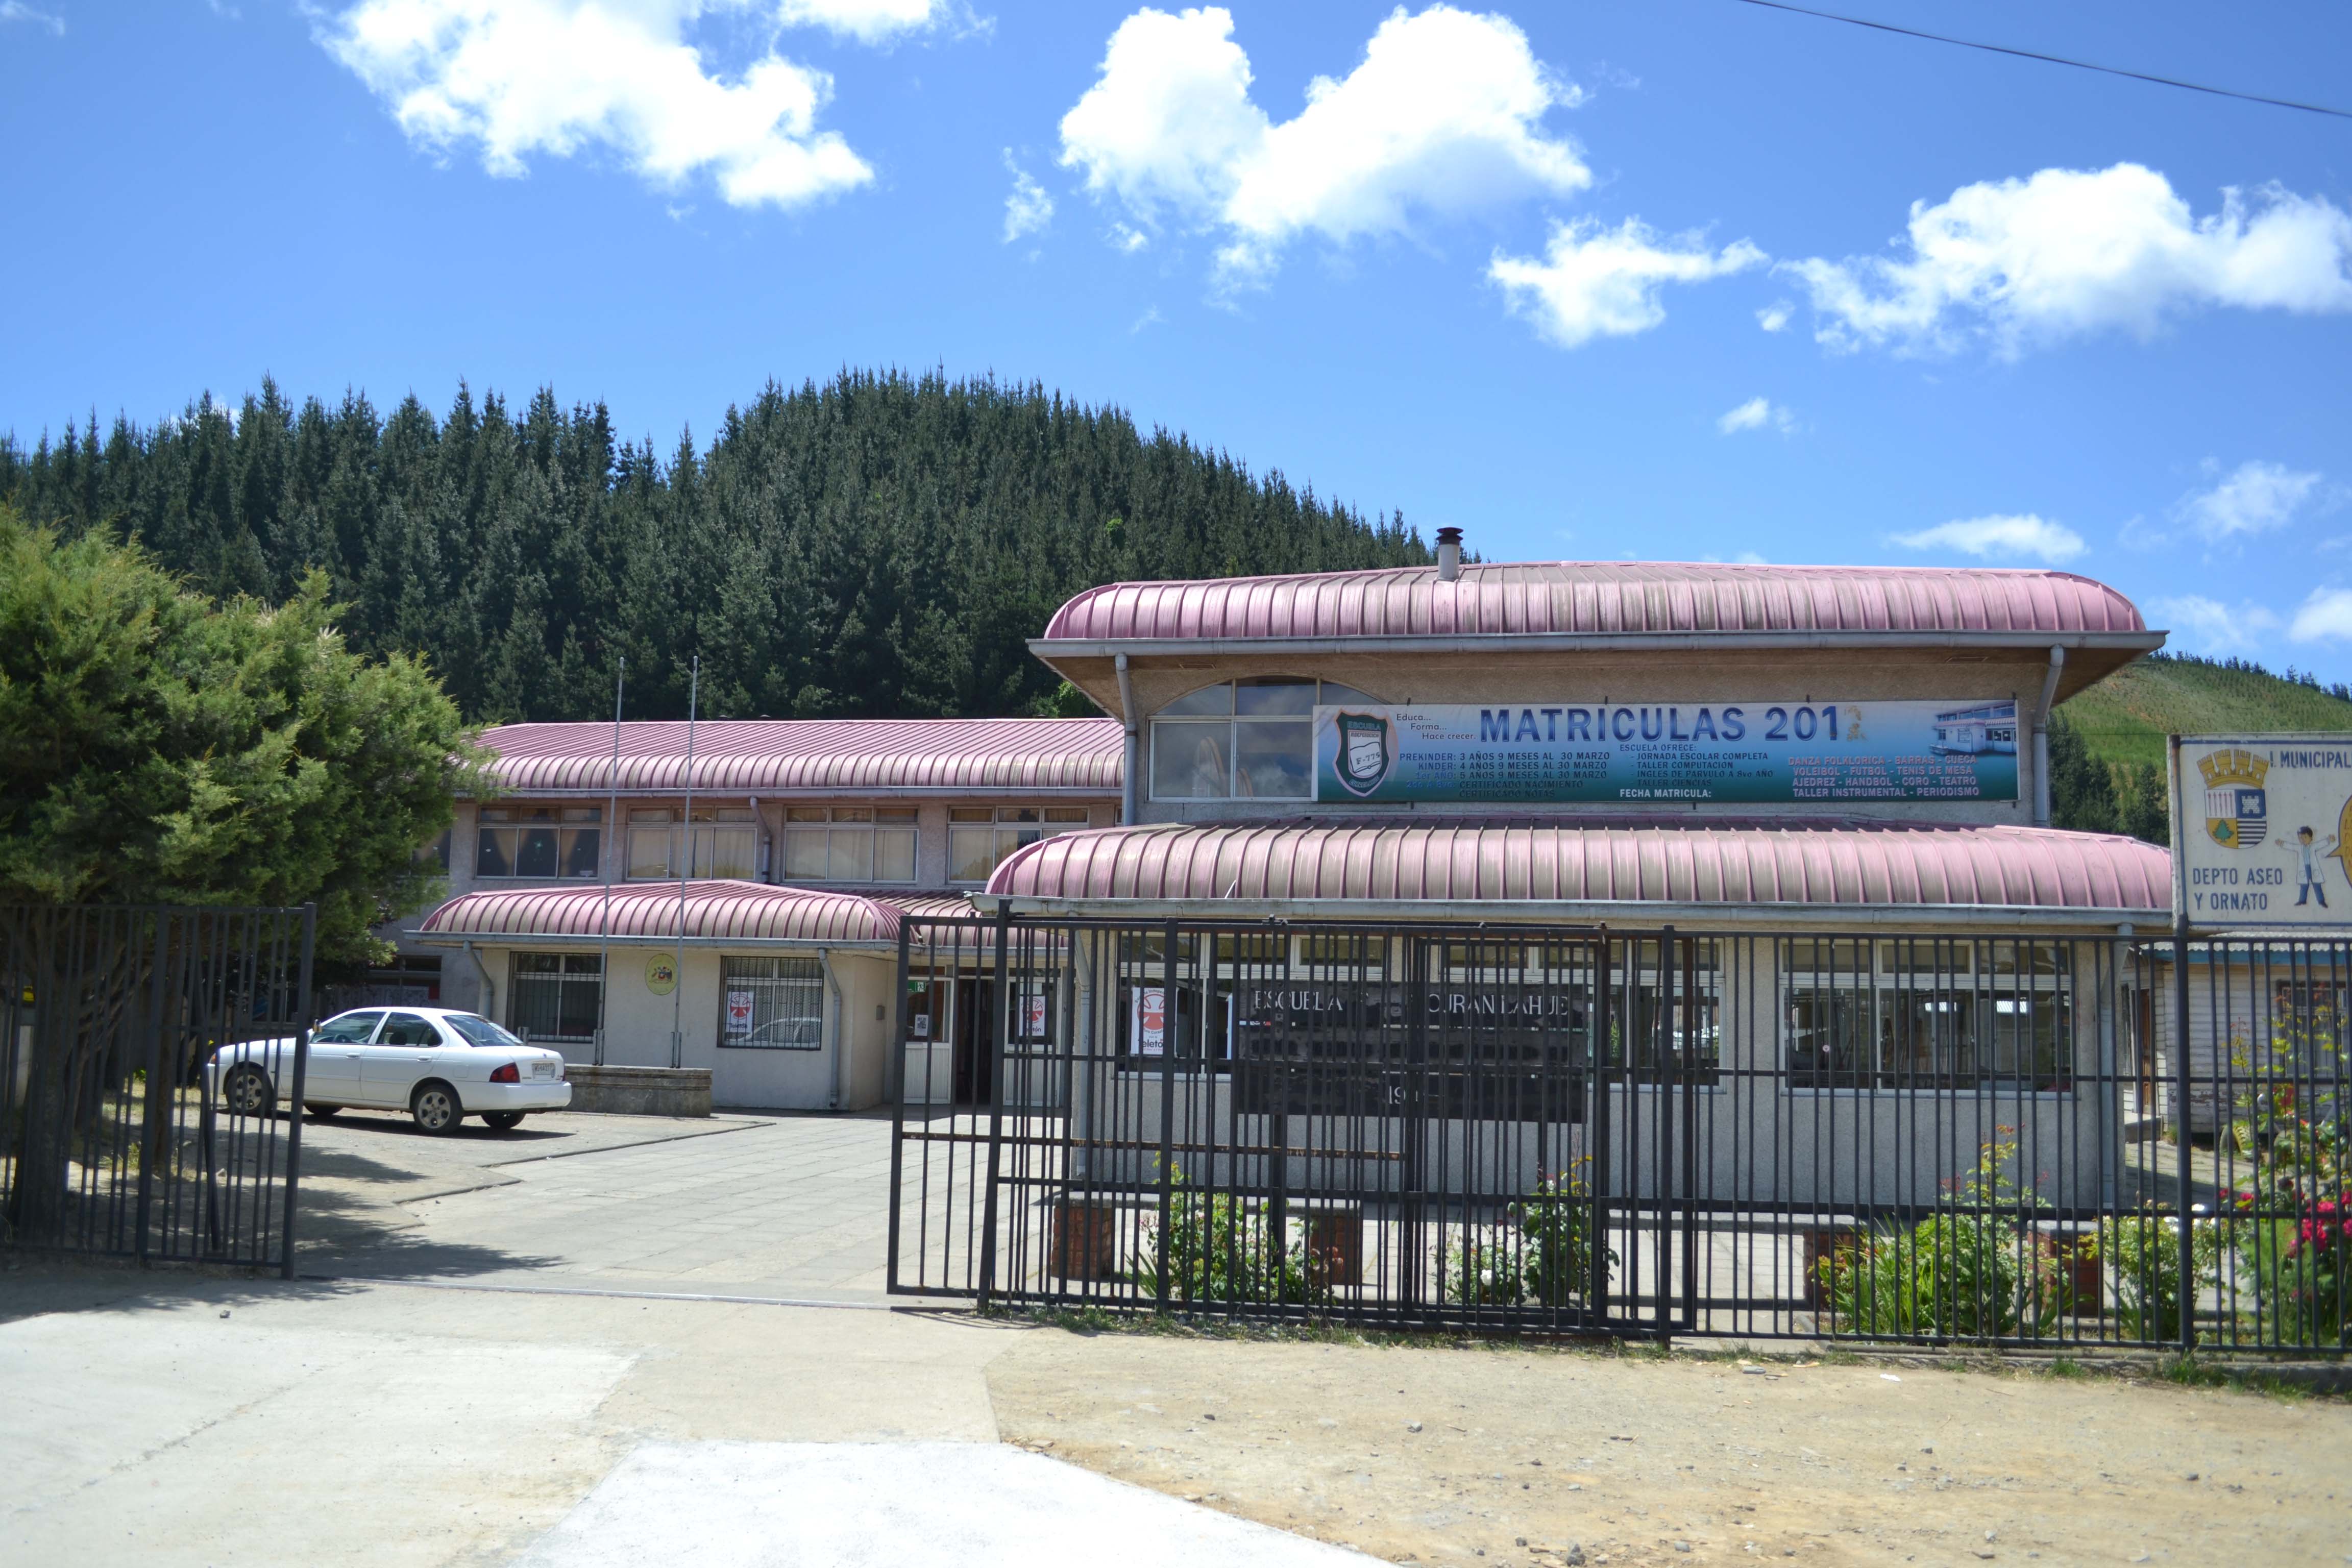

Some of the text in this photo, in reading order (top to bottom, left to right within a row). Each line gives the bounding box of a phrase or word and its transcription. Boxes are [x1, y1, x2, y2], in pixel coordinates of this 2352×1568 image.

[1480, 707, 1745, 742] MATRICULAS
[1400, 752, 1456, 761] PREKINDER:
[1460, 752, 1465, 761] 3
[1469, 751, 1494, 761] AÑOS
[1498, 752, 1504, 761] 9
[1561, 752, 1573, 760] 30
[1577, 752, 1610, 760] MARZO
[1788, 755, 1977, 766] DANZA FOLKLORICA BARRAS CUECA
[1418, 762, 1456, 770] KINDER:
[1469, 761, 1494, 770] AÑOS
[1435, 770, 1456, 779] AÑO:
[1460, 771, 1465, 779] 5
[1469, 770, 1494, 779] AÑOS
[1498, 771, 1504, 779] 9
[1755, 769, 1773, 777] AÑO
[1793, 766, 1973, 776] VOLEIBOL FUTBOL TENIS DE MESA
[1459, 780, 1521, 789] CERTIFICADO
[1792, 776, 1976, 787] AJEDREZ HANDBOL CORO TEATRO
[1459, 790, 1521, 798] CERTIFICADO
[1620, 789, 1711, 797] FECHA MATRICULA:
[1793, 787, 1979, 797] TALLER INSTRUMENTAL PERIODISMO
[2192, 868, 2283, 885] DEPTO ASEO
[2194, 893, 2267, 910] Y ORNATO
